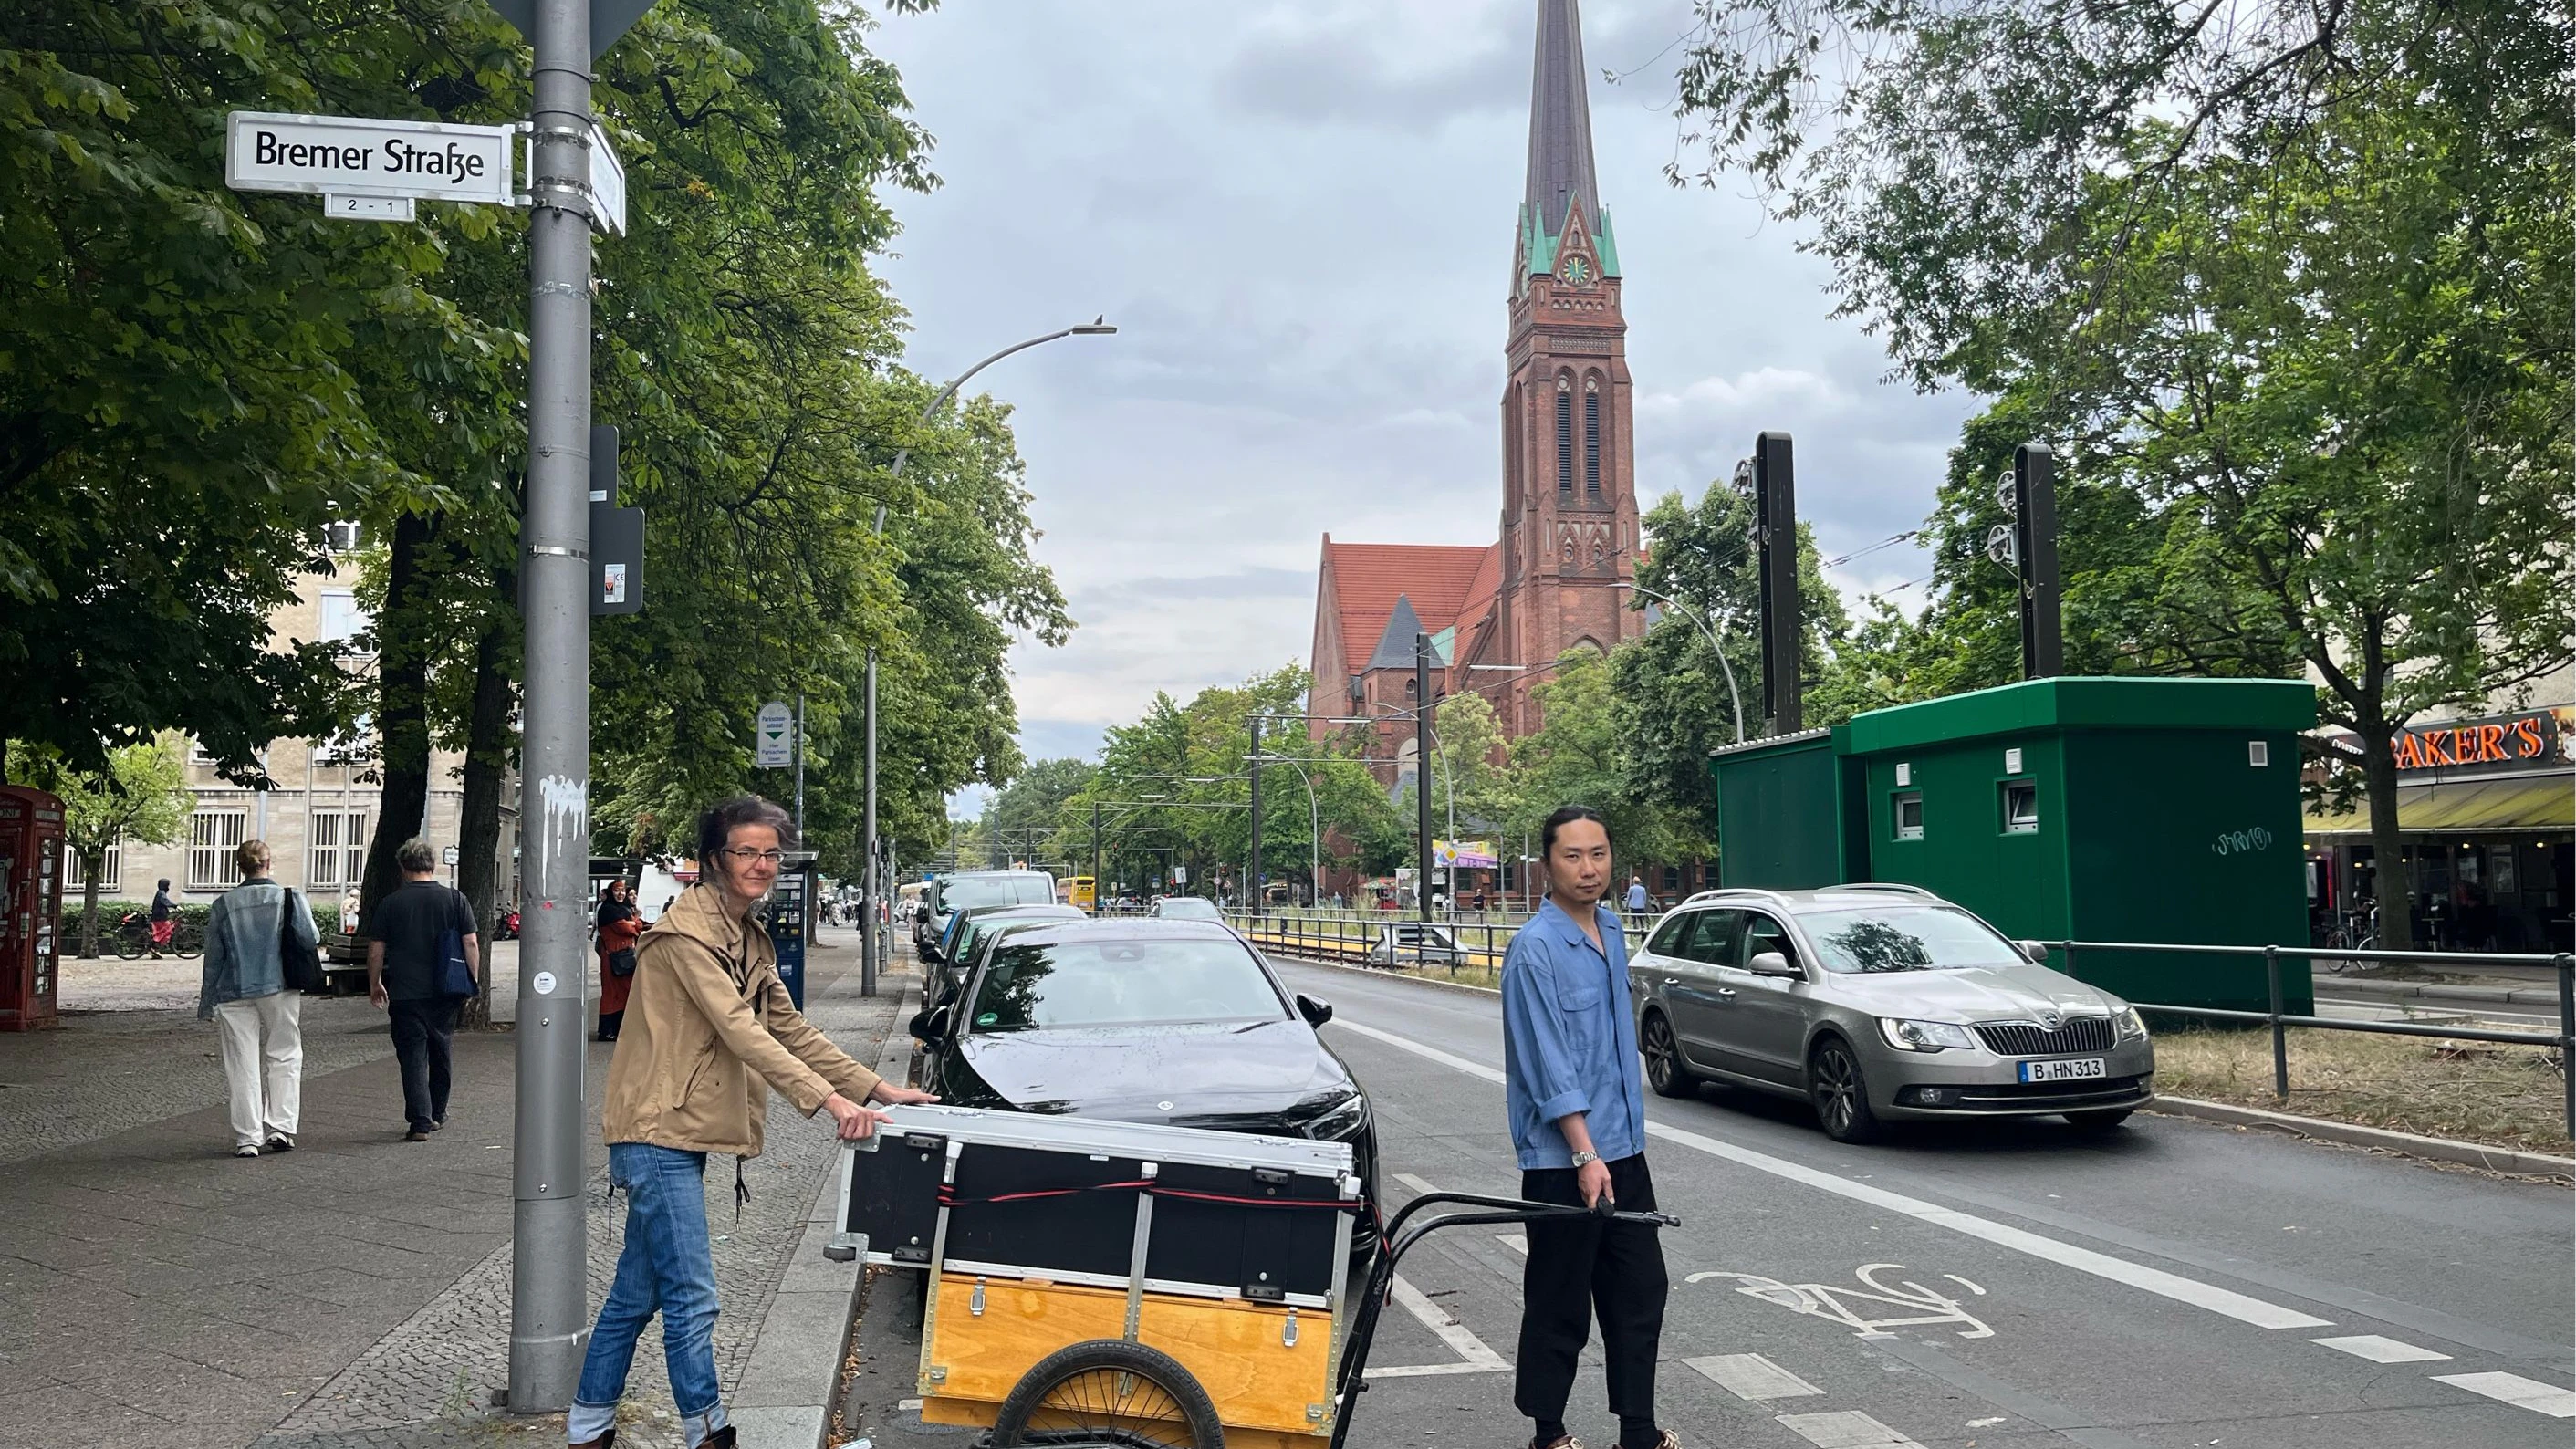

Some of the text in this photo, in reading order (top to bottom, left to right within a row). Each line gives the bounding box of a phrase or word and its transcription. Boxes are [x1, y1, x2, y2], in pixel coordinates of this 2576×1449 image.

[256, 131, 485, 184] Bremer Straße
[348, 199, 357, 211] 2
[387, 201, 393, 213] 1
[2034, 1064, 2045, 1079] B
